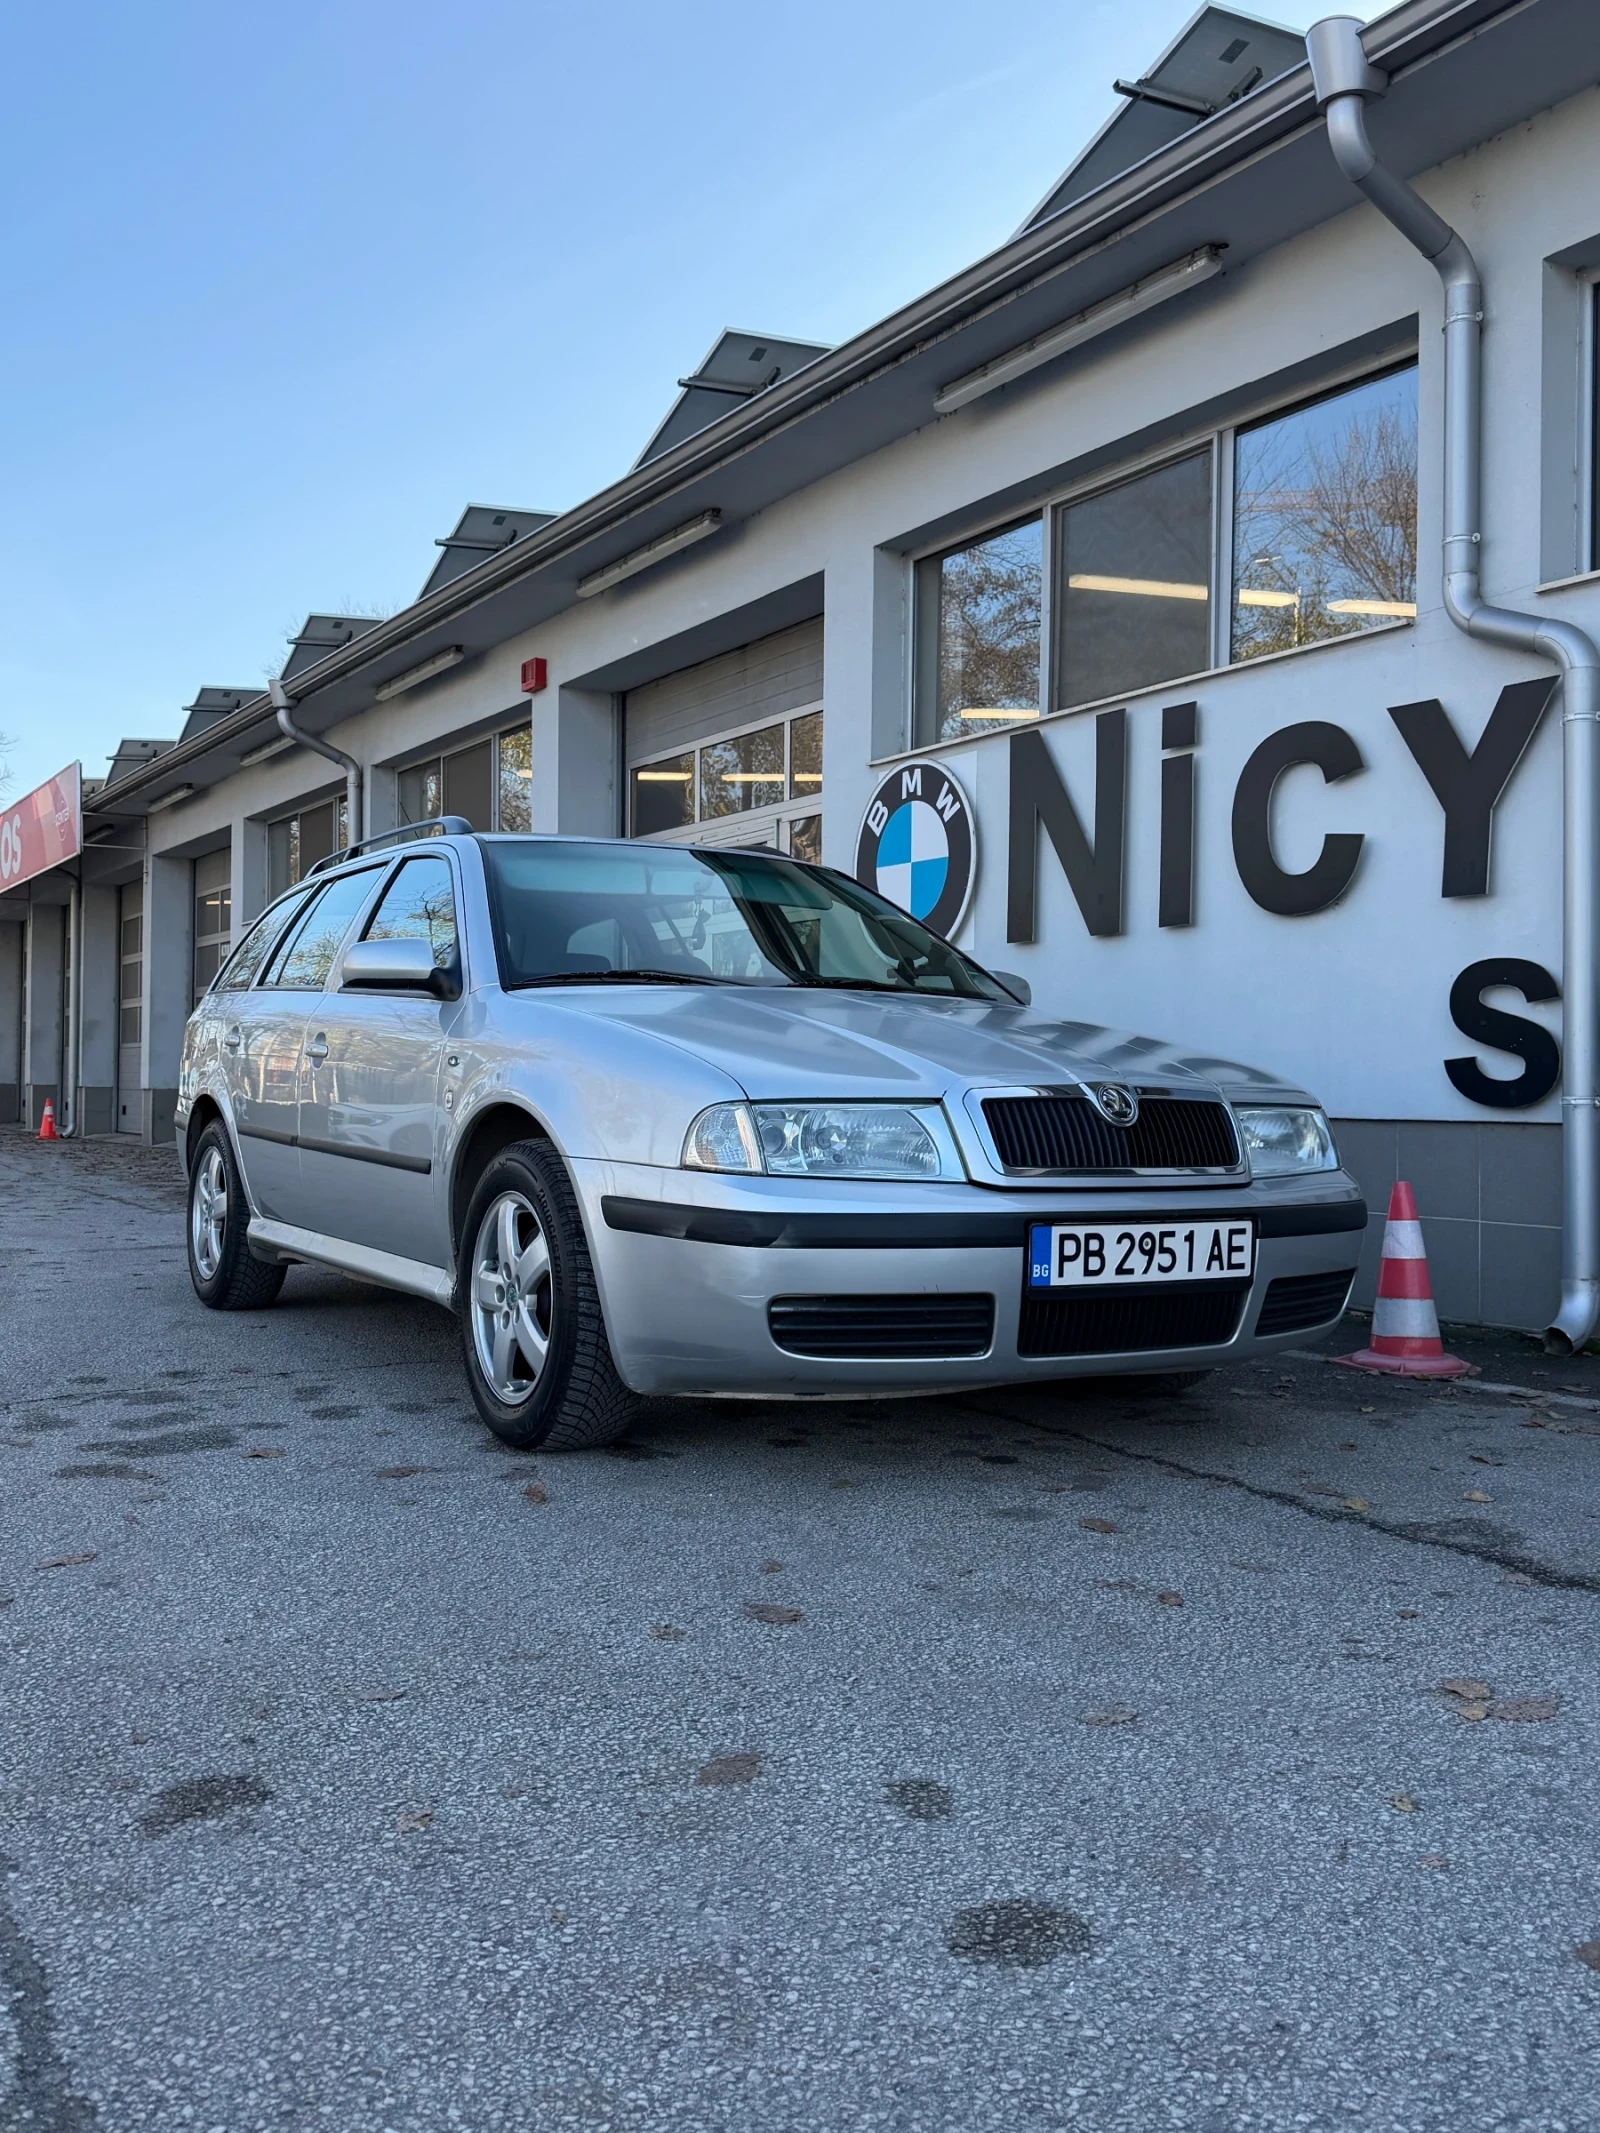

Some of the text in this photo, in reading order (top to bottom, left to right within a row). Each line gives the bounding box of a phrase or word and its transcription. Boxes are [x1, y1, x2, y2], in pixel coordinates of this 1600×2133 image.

[867, 768, 960, 837] BMW
[1443, 957, 1561, 1108] S
[1032, 1264, 1049, 1278] BG
[1057, 1228, 1247, 1278] PB 2951 AE
